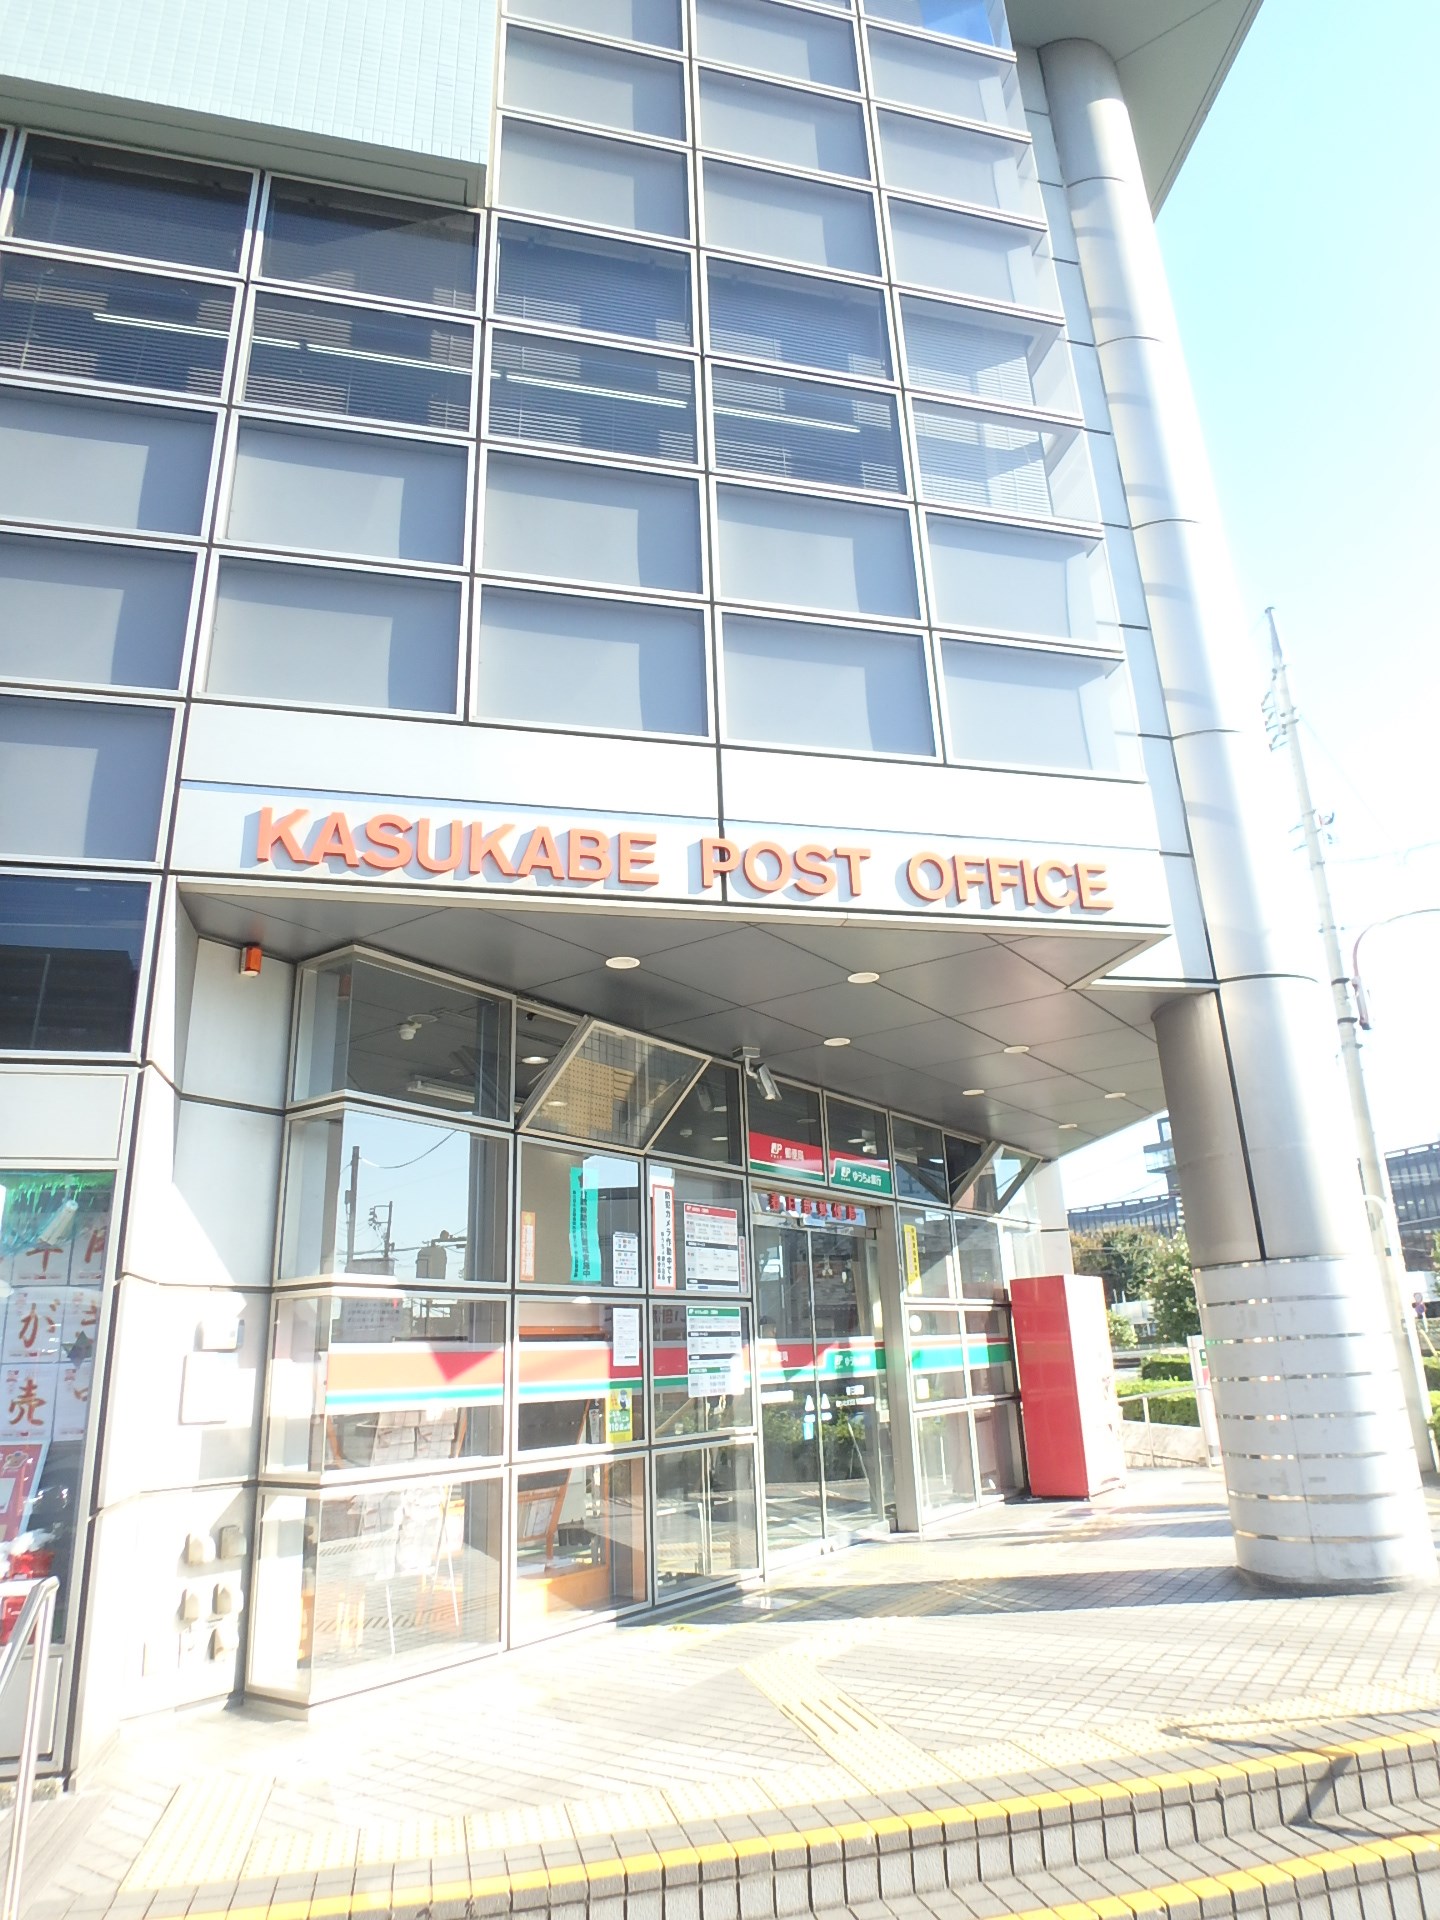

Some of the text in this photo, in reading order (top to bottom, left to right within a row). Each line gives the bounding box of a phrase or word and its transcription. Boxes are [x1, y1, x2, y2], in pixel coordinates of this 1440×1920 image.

[255, 807, 1115, 912] KASUKABE POST OFFICE
